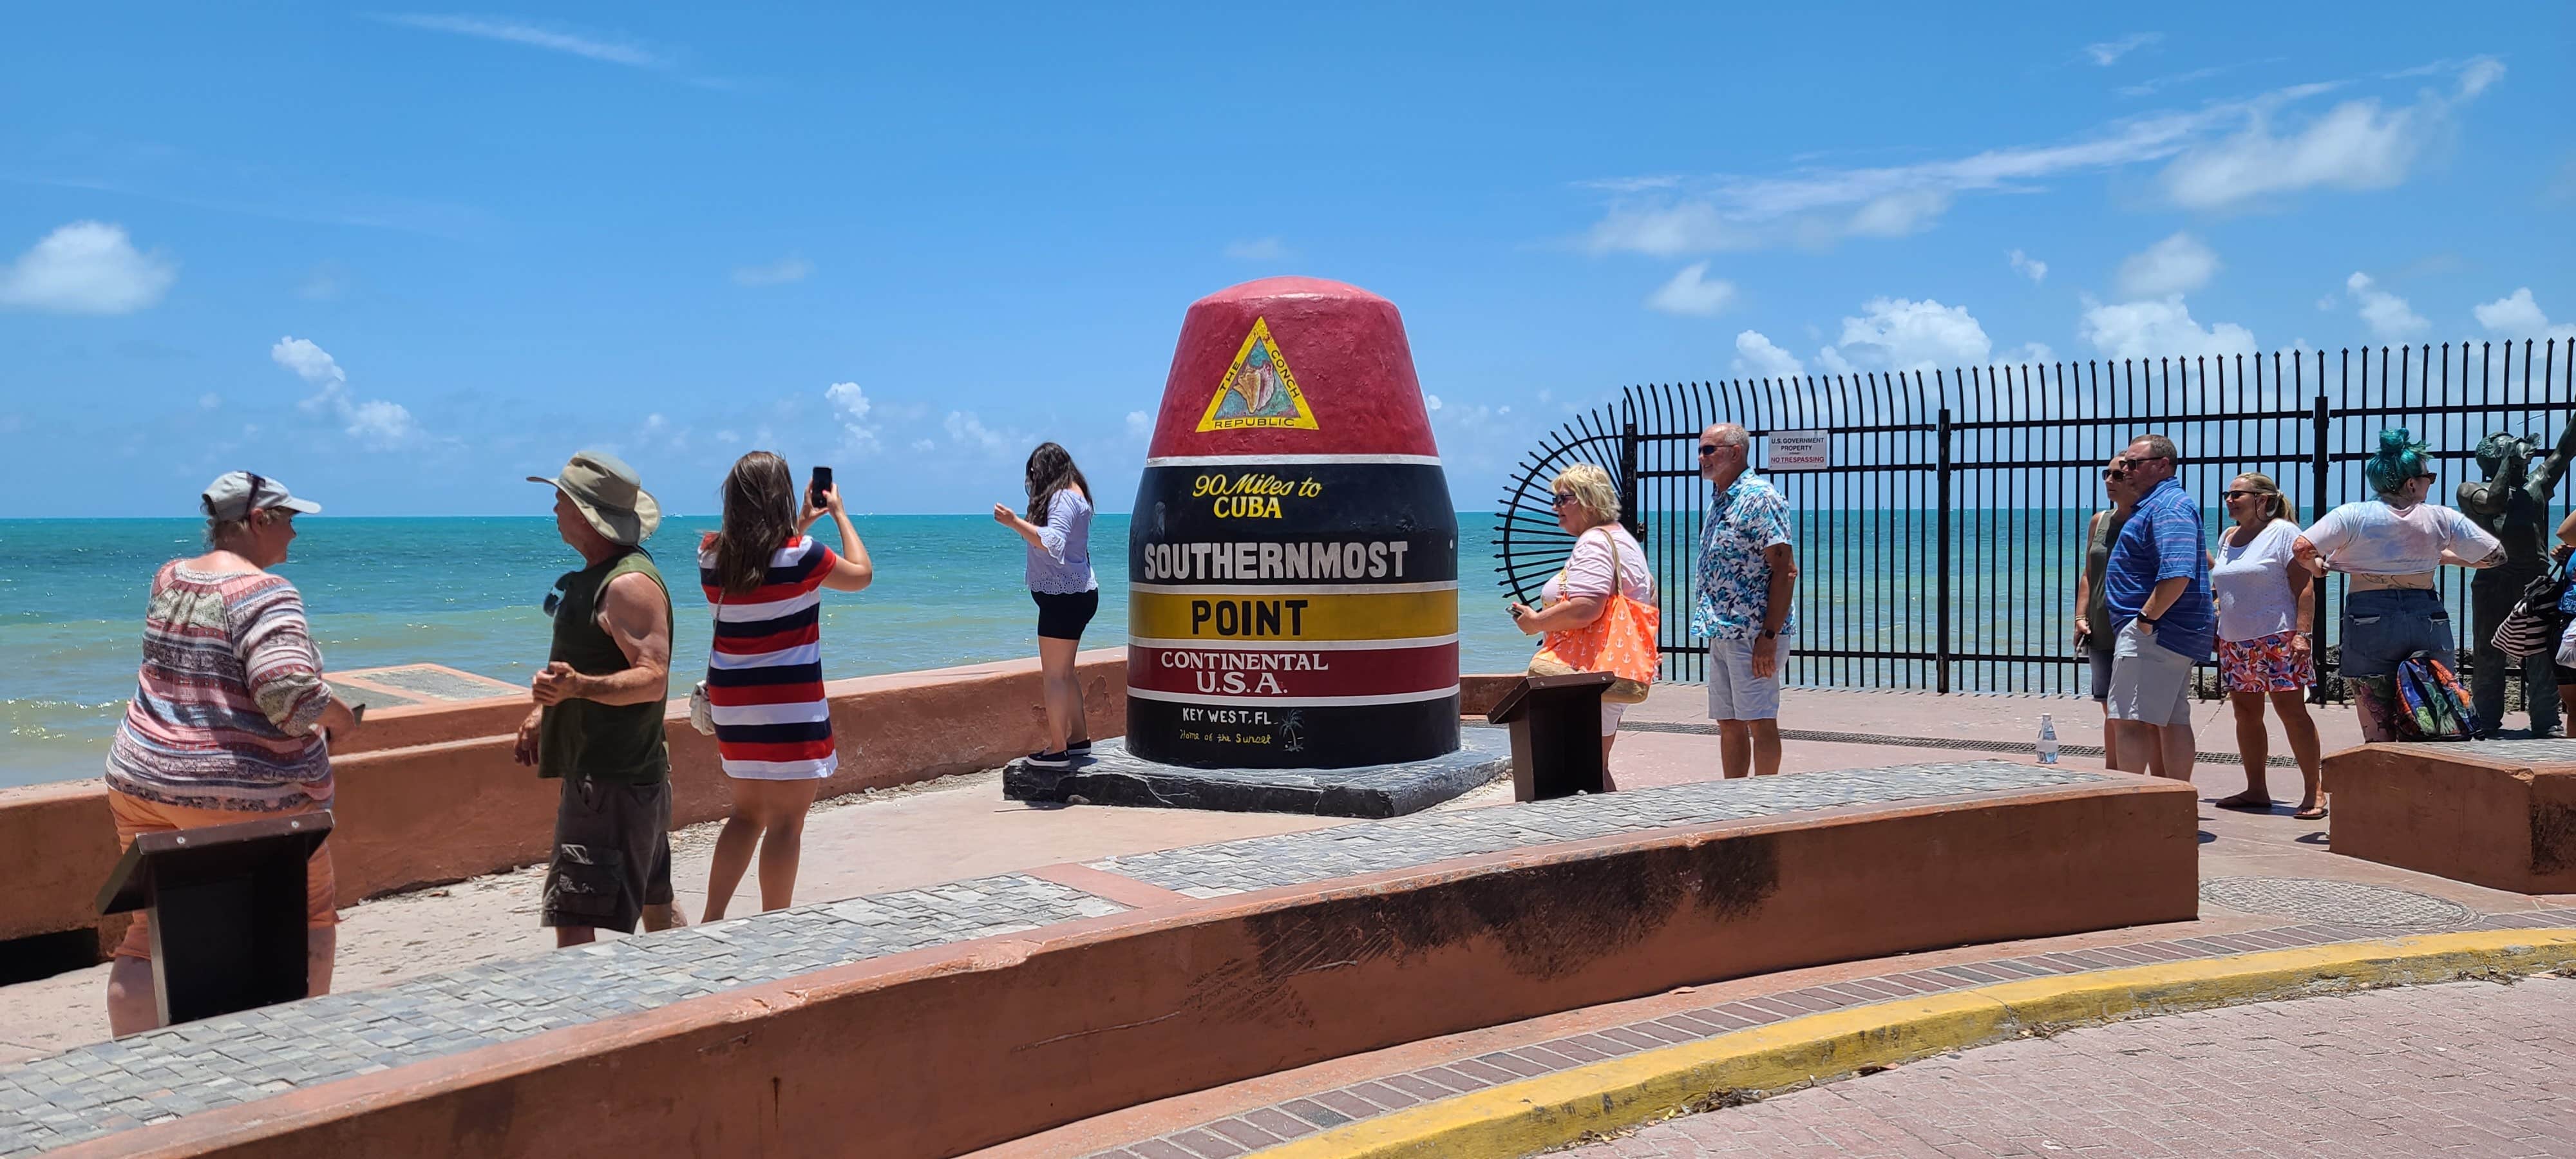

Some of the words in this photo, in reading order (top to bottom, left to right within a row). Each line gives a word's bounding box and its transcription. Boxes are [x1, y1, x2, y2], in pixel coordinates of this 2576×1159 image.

[1220, 361, 1240, 391] THE
[1271, 350, 1300, 398] CONCH
[1215, 419, 1294, 429] REPUBLIC
[1192, 474, 1226, 497] 90
[1223, 473, 1295, 496] Miles
[1298, 477, 1322, 498] to
[1213, 496, 1282, 519] CUBA
[1144, 541, 1408, 580] SOUTHERNMOST
[1192, 599, 1309, 636] POINT
[1161, 652, 1329, 671] CONTINENTAL
[1197, 672, 1288, 694] U.S.A.
[1182, 708, 1204, 721] KEY
[1179, 729, 1199, 740] Home
[1217, 733, 1231, 743] the
[1235, 733, 1272, 744] Sunset
